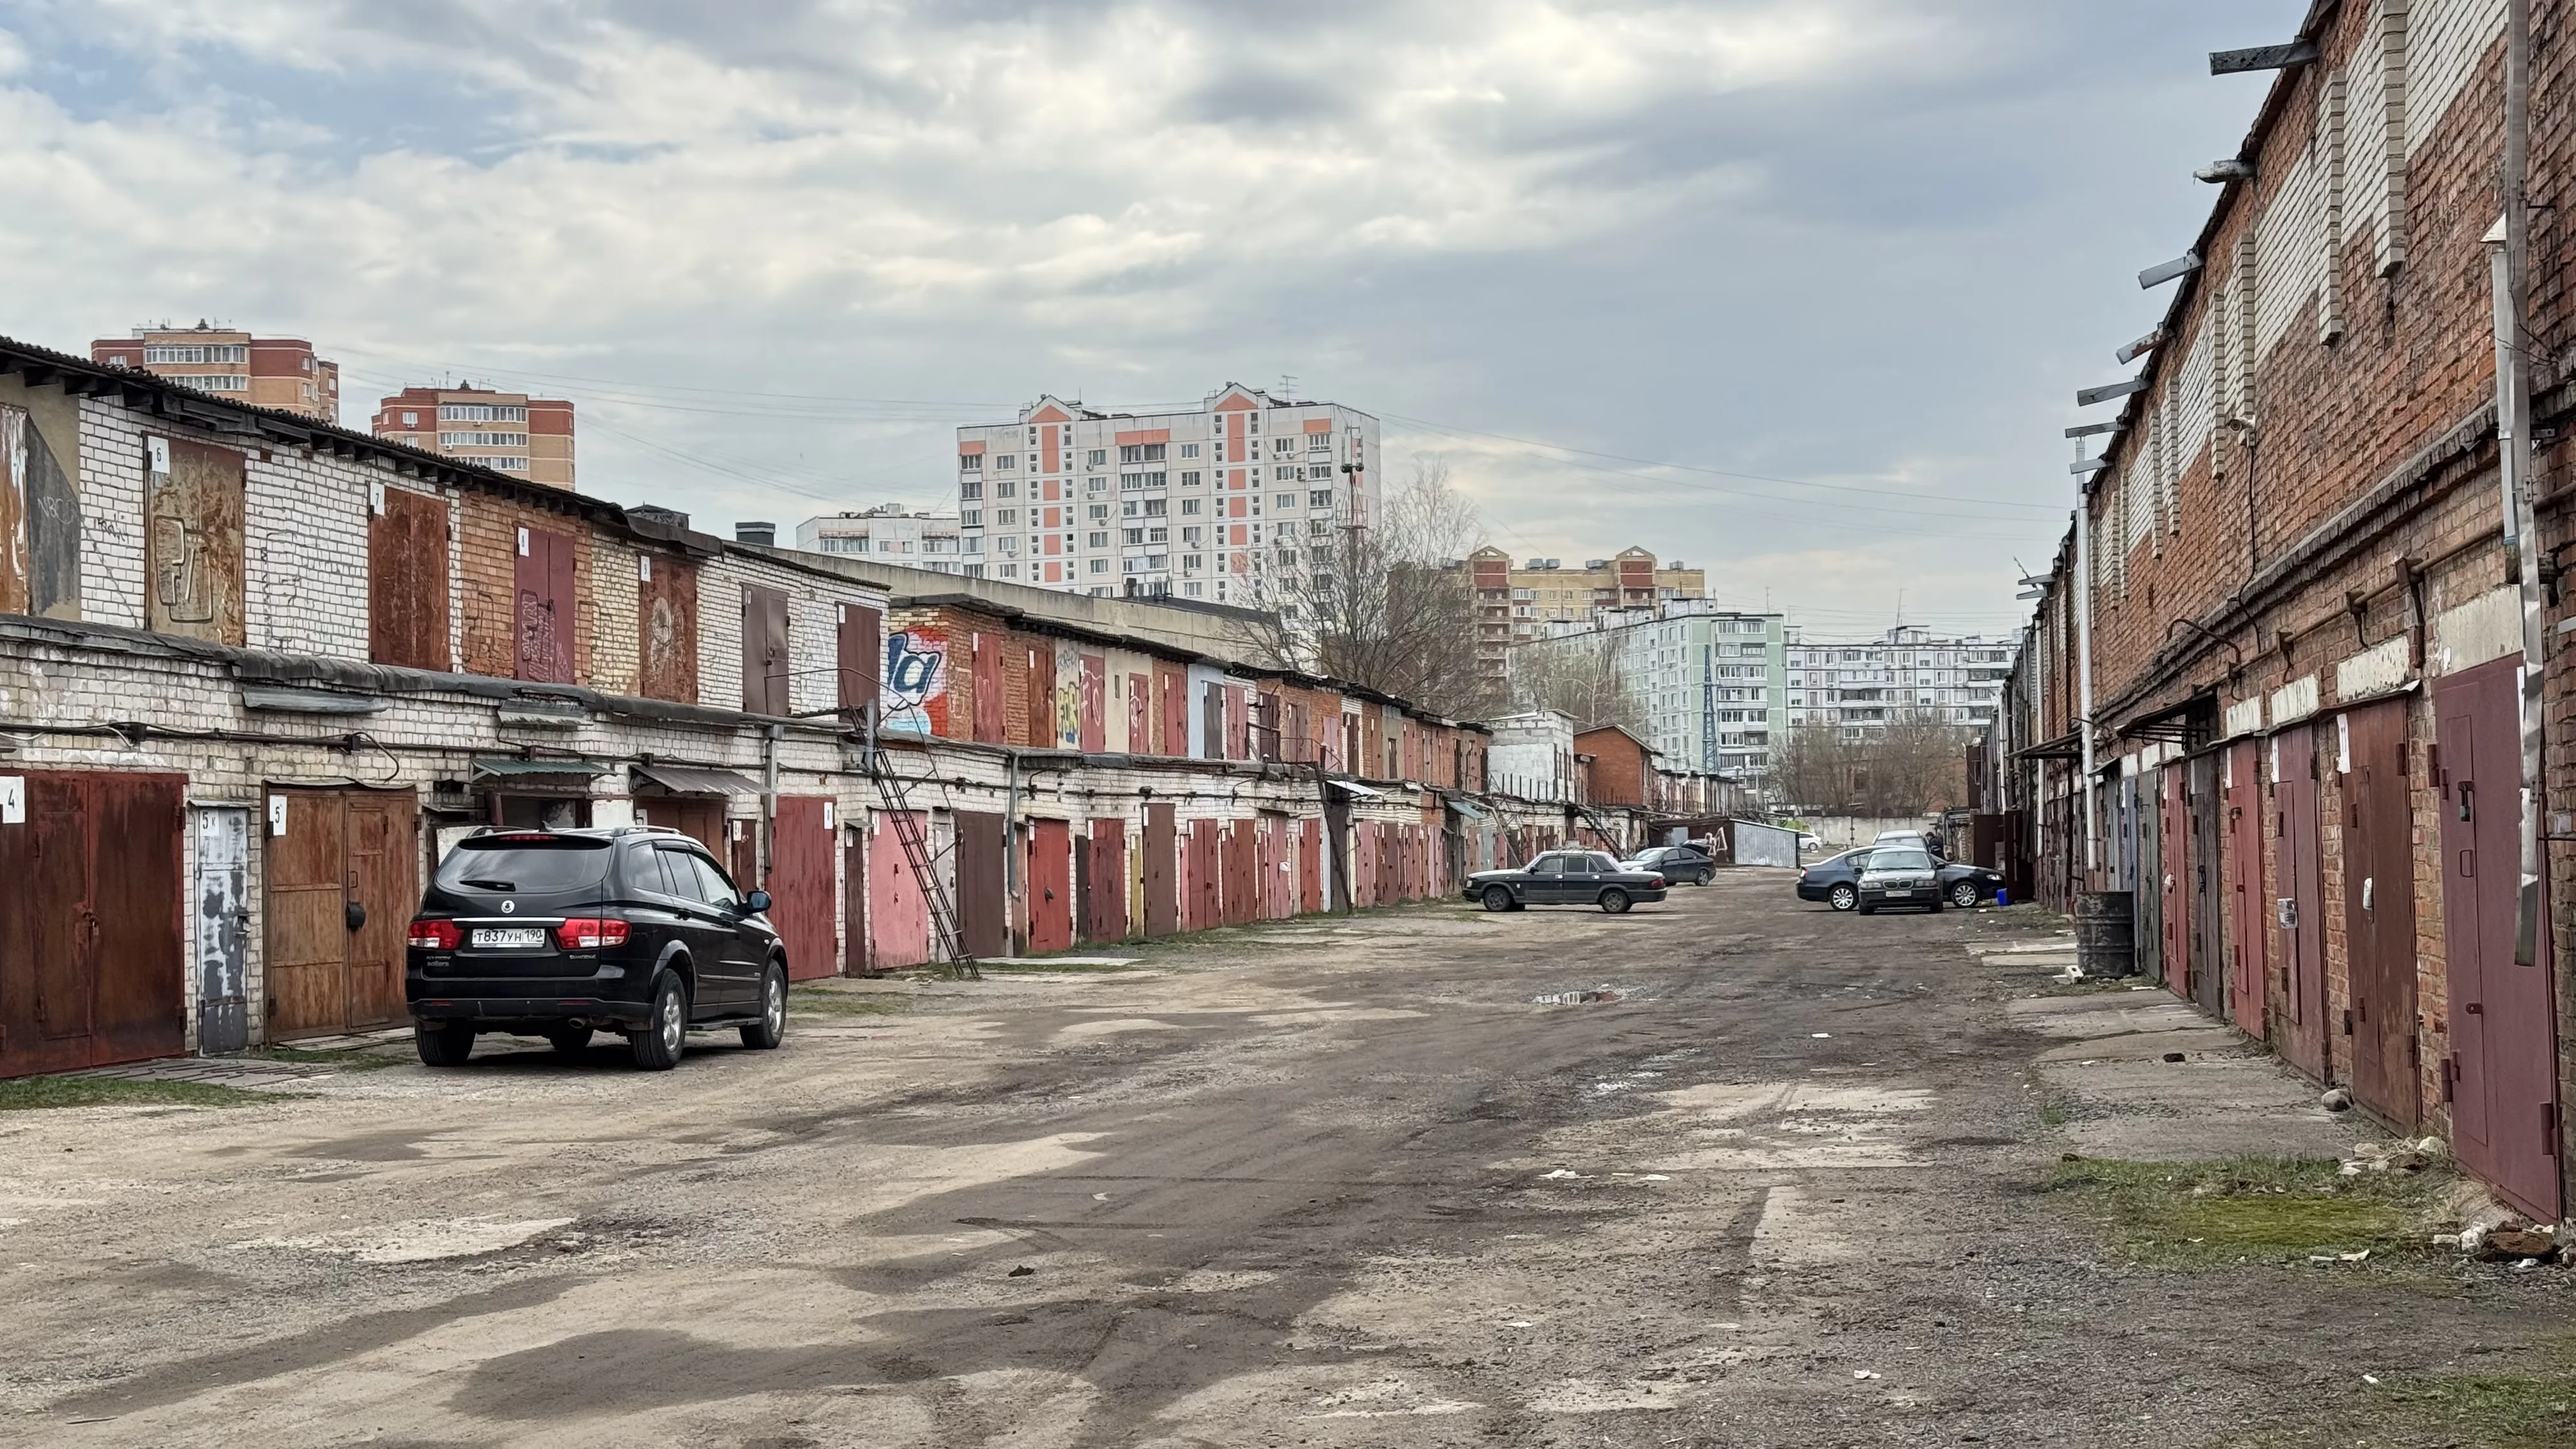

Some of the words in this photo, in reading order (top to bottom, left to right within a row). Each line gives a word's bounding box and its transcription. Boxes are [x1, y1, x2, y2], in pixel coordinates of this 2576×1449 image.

[157, 447, 162, 462] 6
[375, 493, 379, 507] 7
[745, 589, 751, 604] 10
[8, 788, 15, 809] 4
[202, 811, 209, 829] 5
[275, 804, 282, 824] 5
